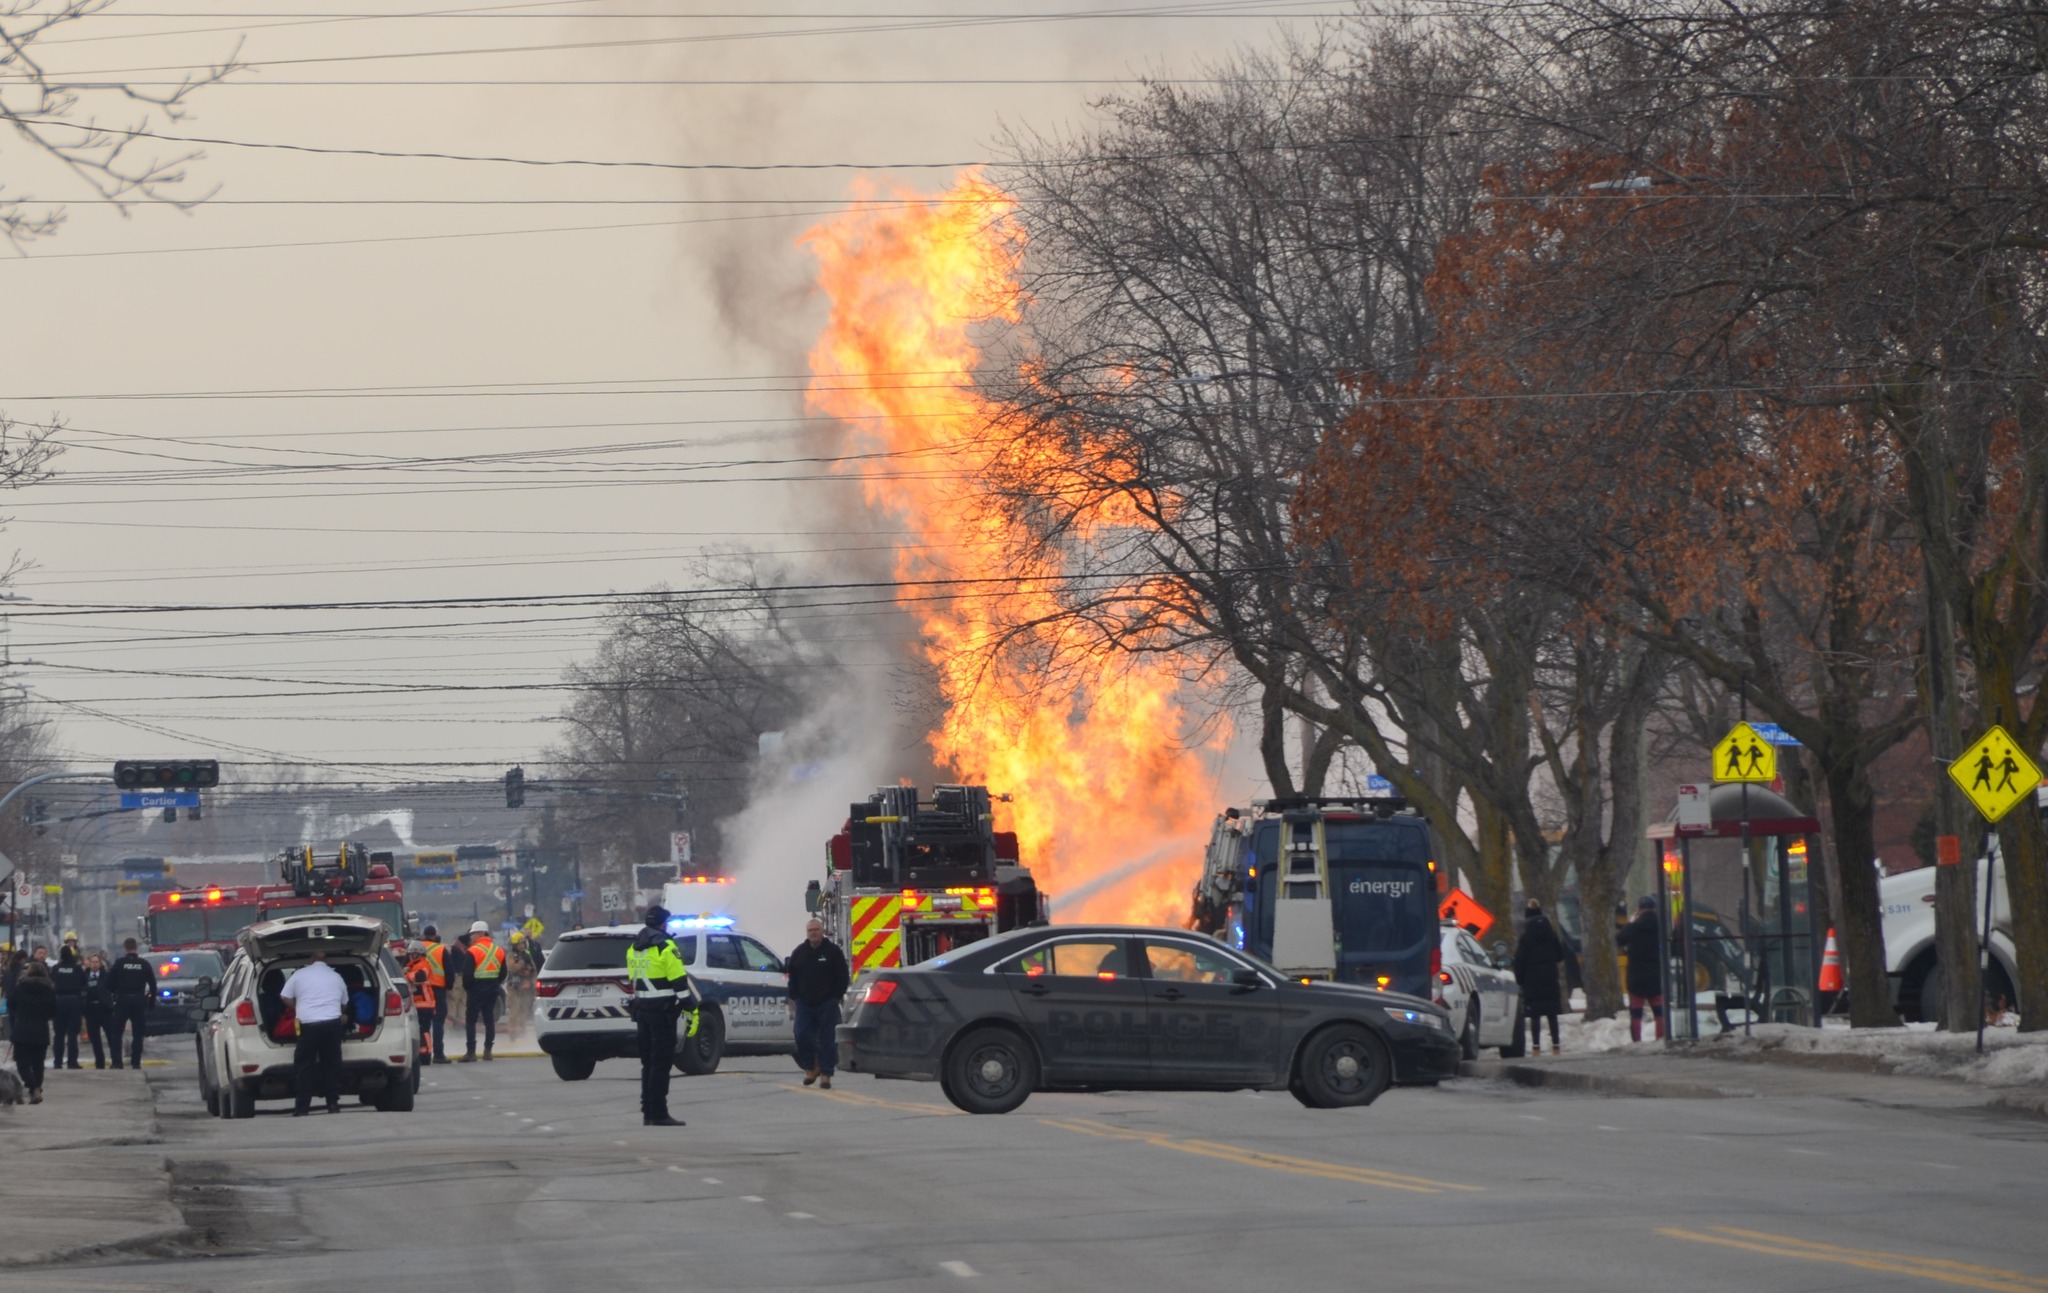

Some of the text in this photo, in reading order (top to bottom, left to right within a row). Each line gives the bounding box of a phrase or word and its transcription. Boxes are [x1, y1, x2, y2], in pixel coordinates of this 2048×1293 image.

[141, 796, 178, 806] Cartier
[603, 893, 618, 909] 50
[627, 958, 651, 969] POLICE
[728, 996, 787, 1016] POLICE
[1047, 1010, 1236, 1038] POLICE
